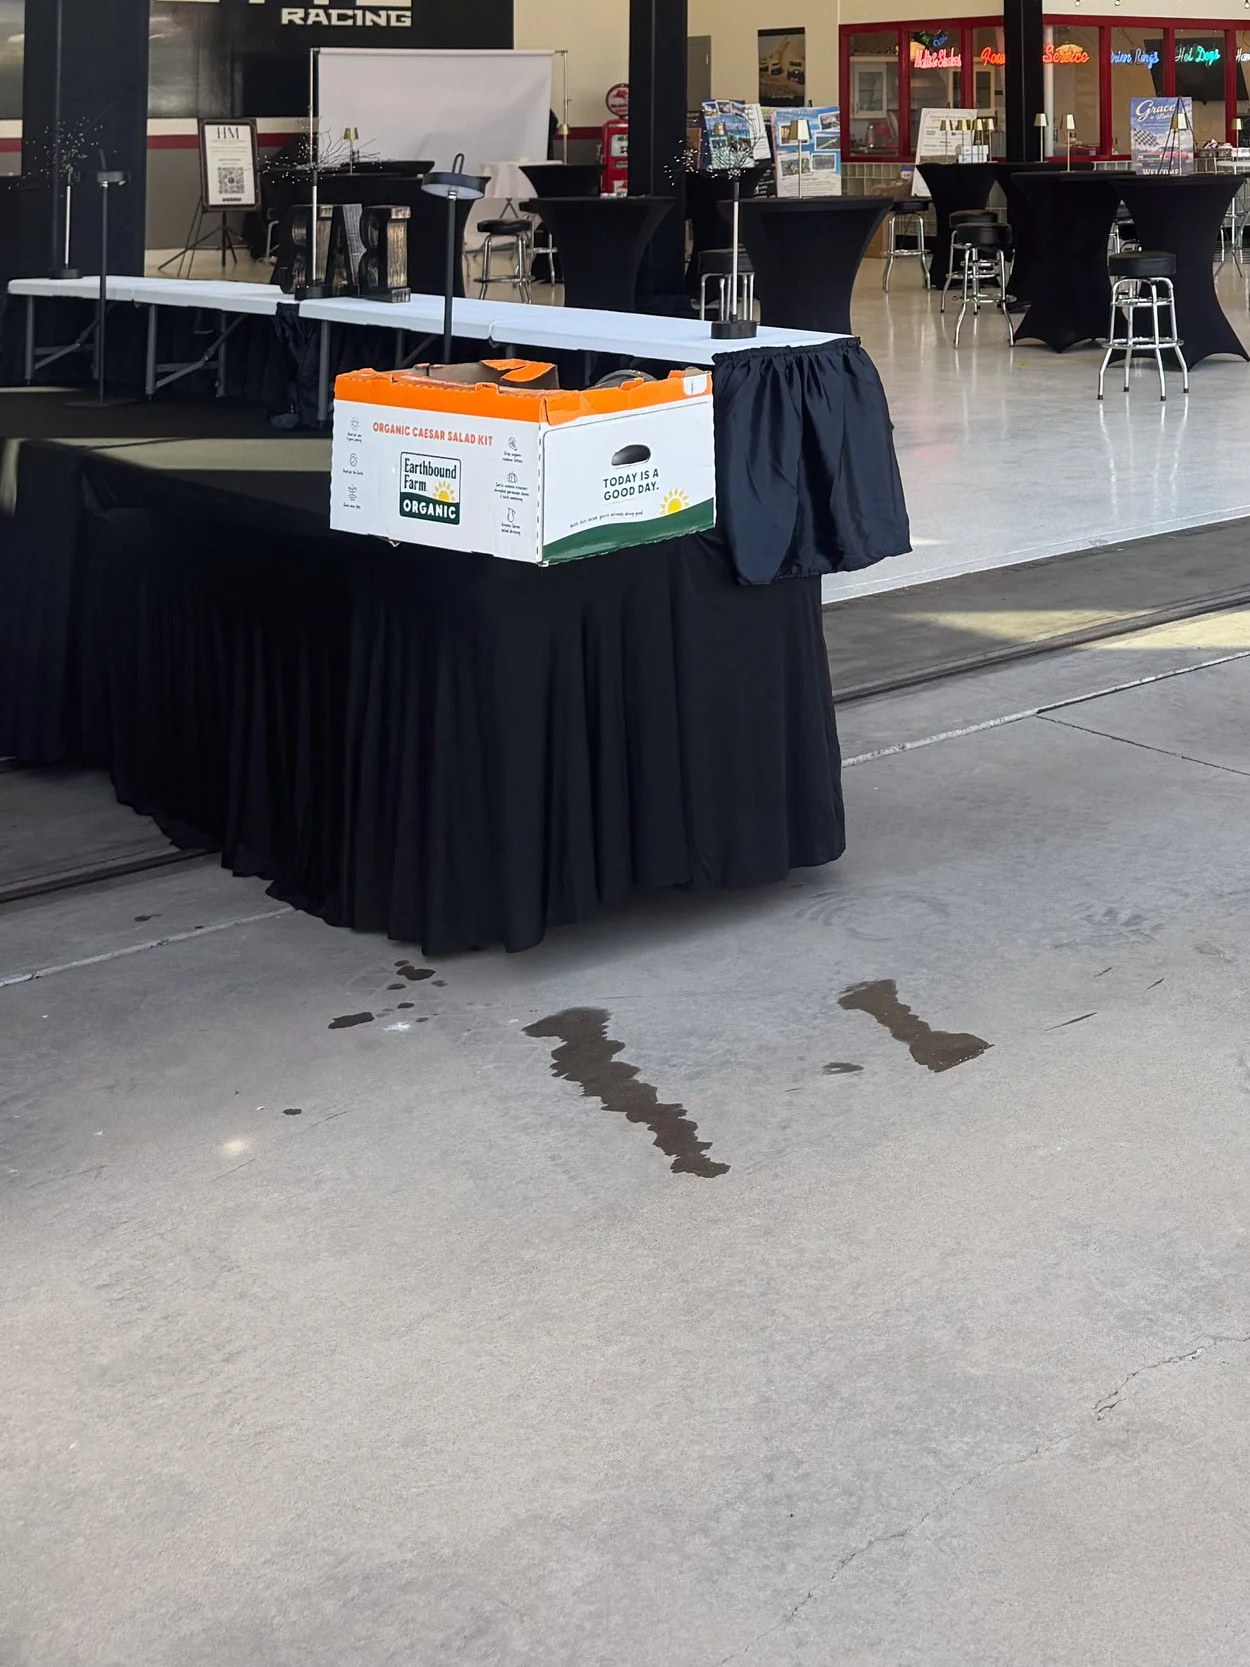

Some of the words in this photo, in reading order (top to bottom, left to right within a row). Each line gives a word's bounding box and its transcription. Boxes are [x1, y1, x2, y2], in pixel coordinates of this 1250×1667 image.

[281, 7, 412, 27] RACING
[1043, 44, 1090, 65] Service
[1111, 49, 1132, 64] nion
[1134, 48, 1160, 70] Rings
[1175, 47, 1194, 62] Hot
[1195, 45, 1221, 67] Dogs
[1135, 99, 1176, 123] Grace
[372, 421, 411, 436] ORGANIC
[412, 426, 446, 441] CAESAR
[447, 431, 477, 444] SALAD
[478, 434, 494, 446] KIT
[404, 457, 457, 480] Earthbound
[603, 472, 638, 488] TODAY
[640, 470, 650, 481] IS
[652, 468, 659, 478] A
[403, 474, 427, 492] Farm
[603, 486, 635, 501] GOOD
[638, 481, 660, 494] DAY.
[402, 499, 457, 519] ORGANIC
